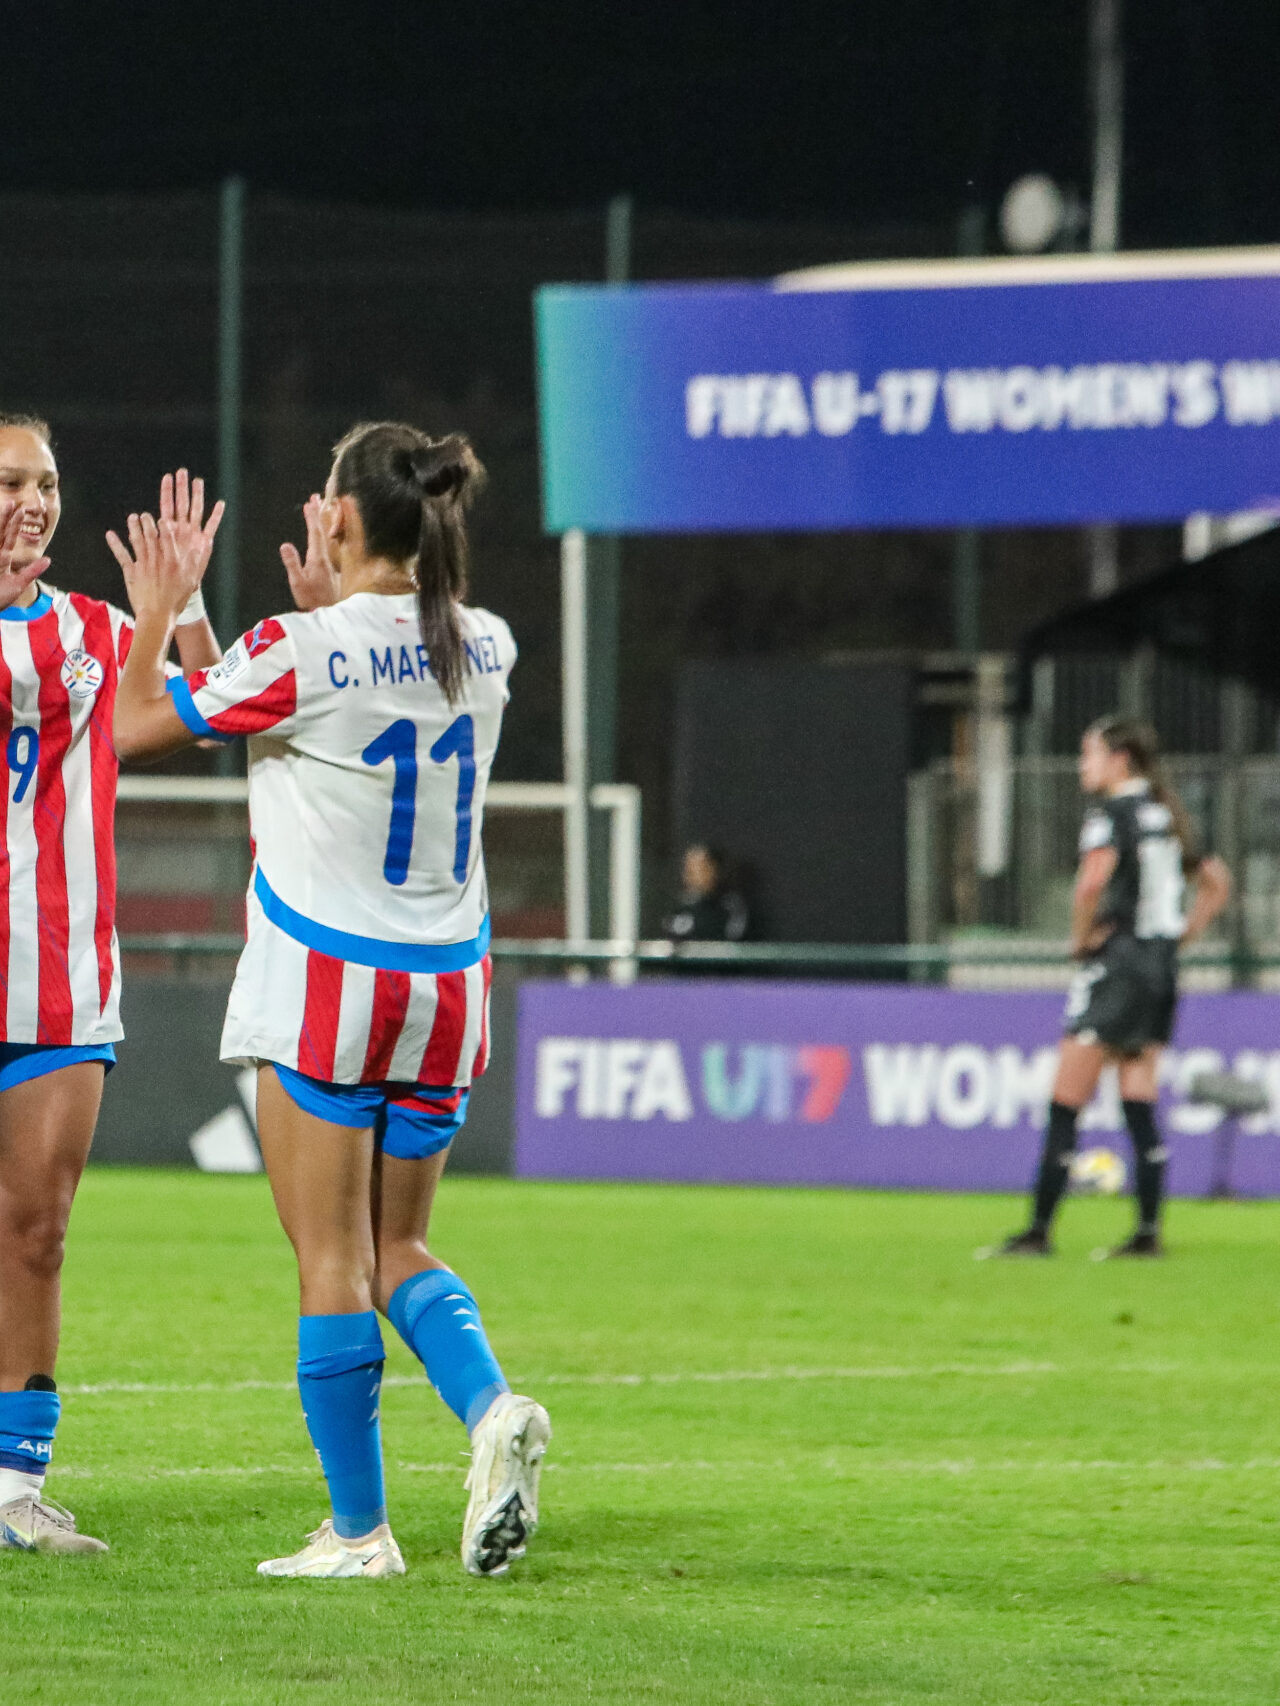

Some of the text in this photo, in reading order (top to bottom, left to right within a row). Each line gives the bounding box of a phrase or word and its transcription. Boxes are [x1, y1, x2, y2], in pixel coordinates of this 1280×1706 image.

[686, 373, 810, 438] FIFA
[812, 369, 939, 437] U-17
[943, 360, 1219, 432] WOMEN'S
[328, 651, 360, 688] C.
[6, 726, 40, 803] 9
[361, 714, 477, 886] 11
[536, 1037, 693, 1122] FIFA
[702, 1043, 852, 1123] U17
